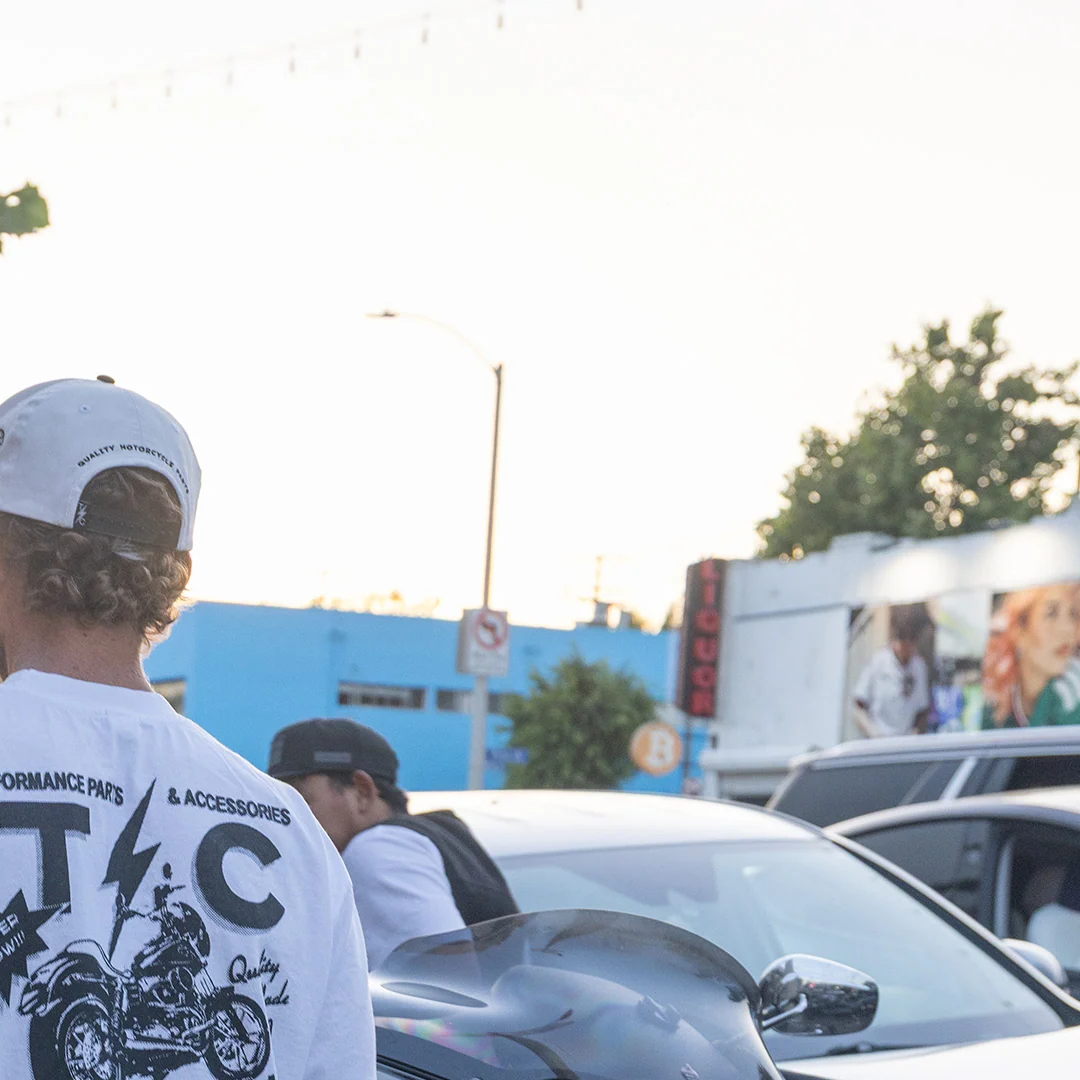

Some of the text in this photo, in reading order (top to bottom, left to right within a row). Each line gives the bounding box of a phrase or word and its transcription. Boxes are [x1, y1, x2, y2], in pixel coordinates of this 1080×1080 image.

[77, 444, 115, 467] QUALITY
[689, 559, 720, 717] LIQUOR
[168, 787, 291, 826] & ACCESSORIES
[262, 979, 289, 1006] ade
